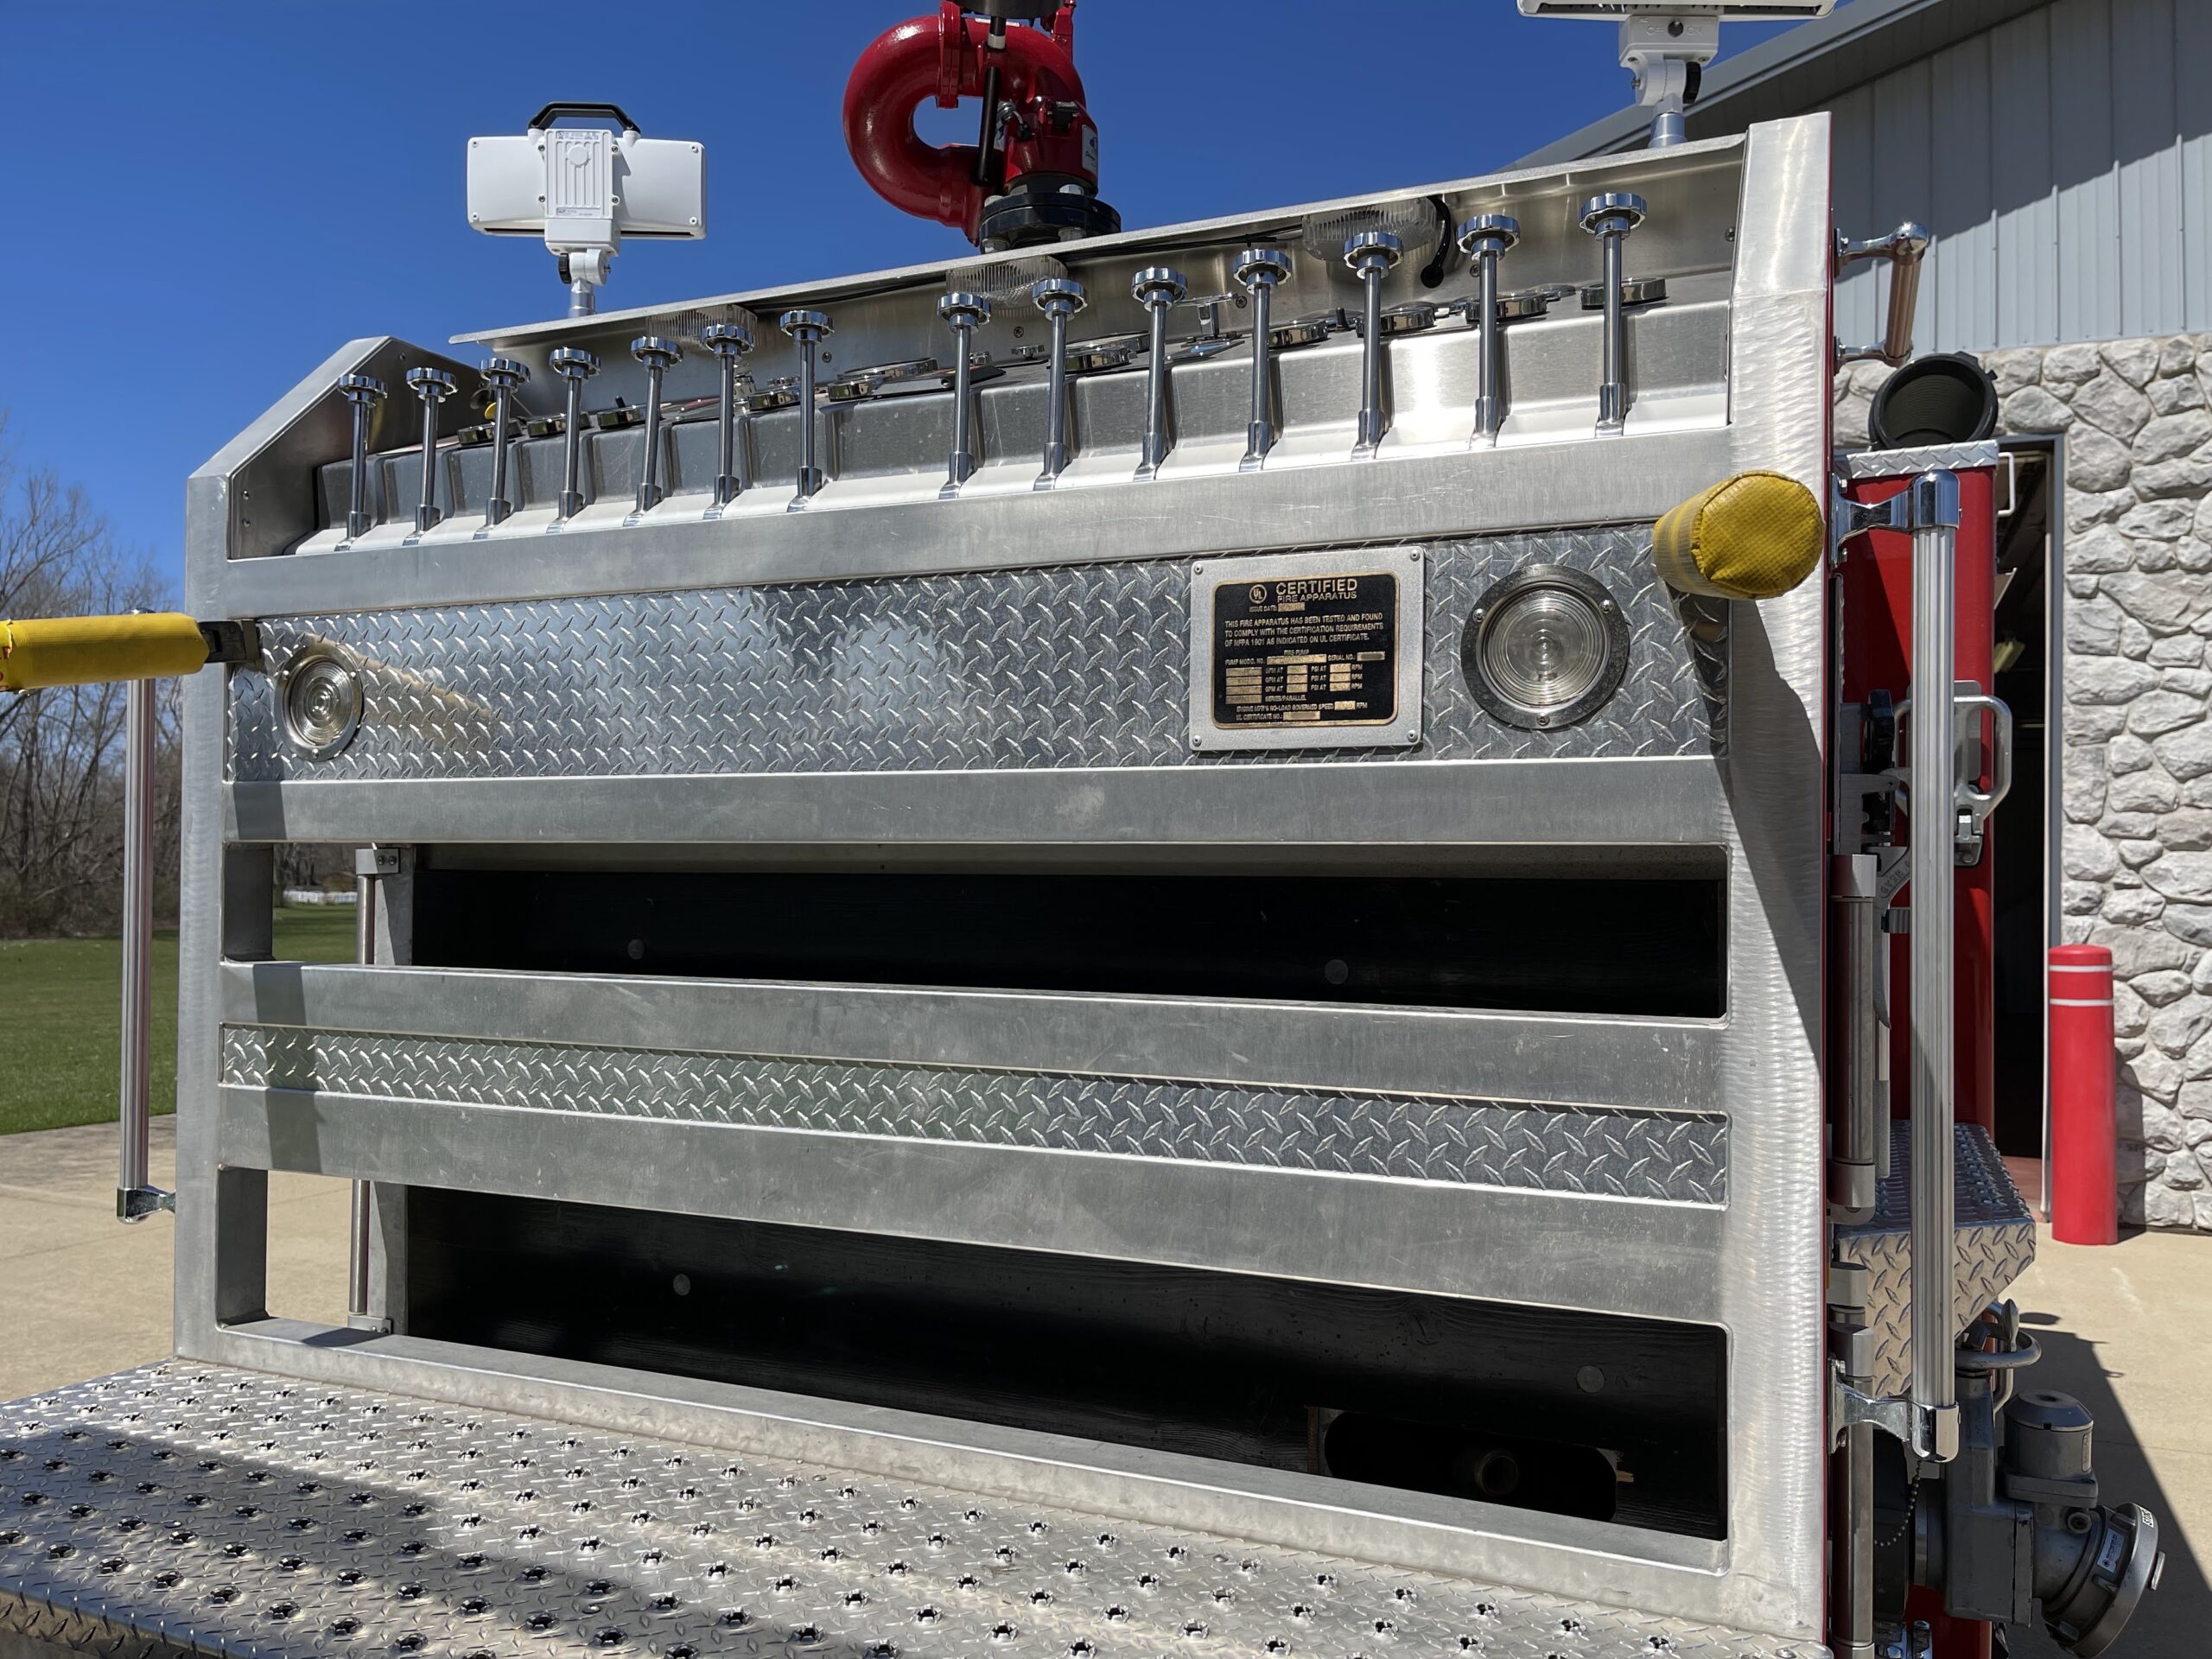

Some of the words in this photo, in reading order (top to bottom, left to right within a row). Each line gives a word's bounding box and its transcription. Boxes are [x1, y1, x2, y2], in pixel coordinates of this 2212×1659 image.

[1276, 578, 1357, 595] CERTIFIED
[1277, 594, 1298, 603] FIRE
[1300, 591, 1357, 602] APPARATUS
[1254, 617, 1289, 626] APPARATUS
[1305, 615, 1321, 624] BEEN
[1322, 614, 1345, 623] TESTED
[1362, 612, 1383, 620] FOUND
[1260, 627, 1275, 636] WITH
[1289, 625, 1334, 634] CERTIFICATION
[1336, 622, 1384, 632] REQUIREMENTS
[1276, 636, 1307, 645] INDICATED
[1329, 632, 1370, 643] CERTIFICATE.
